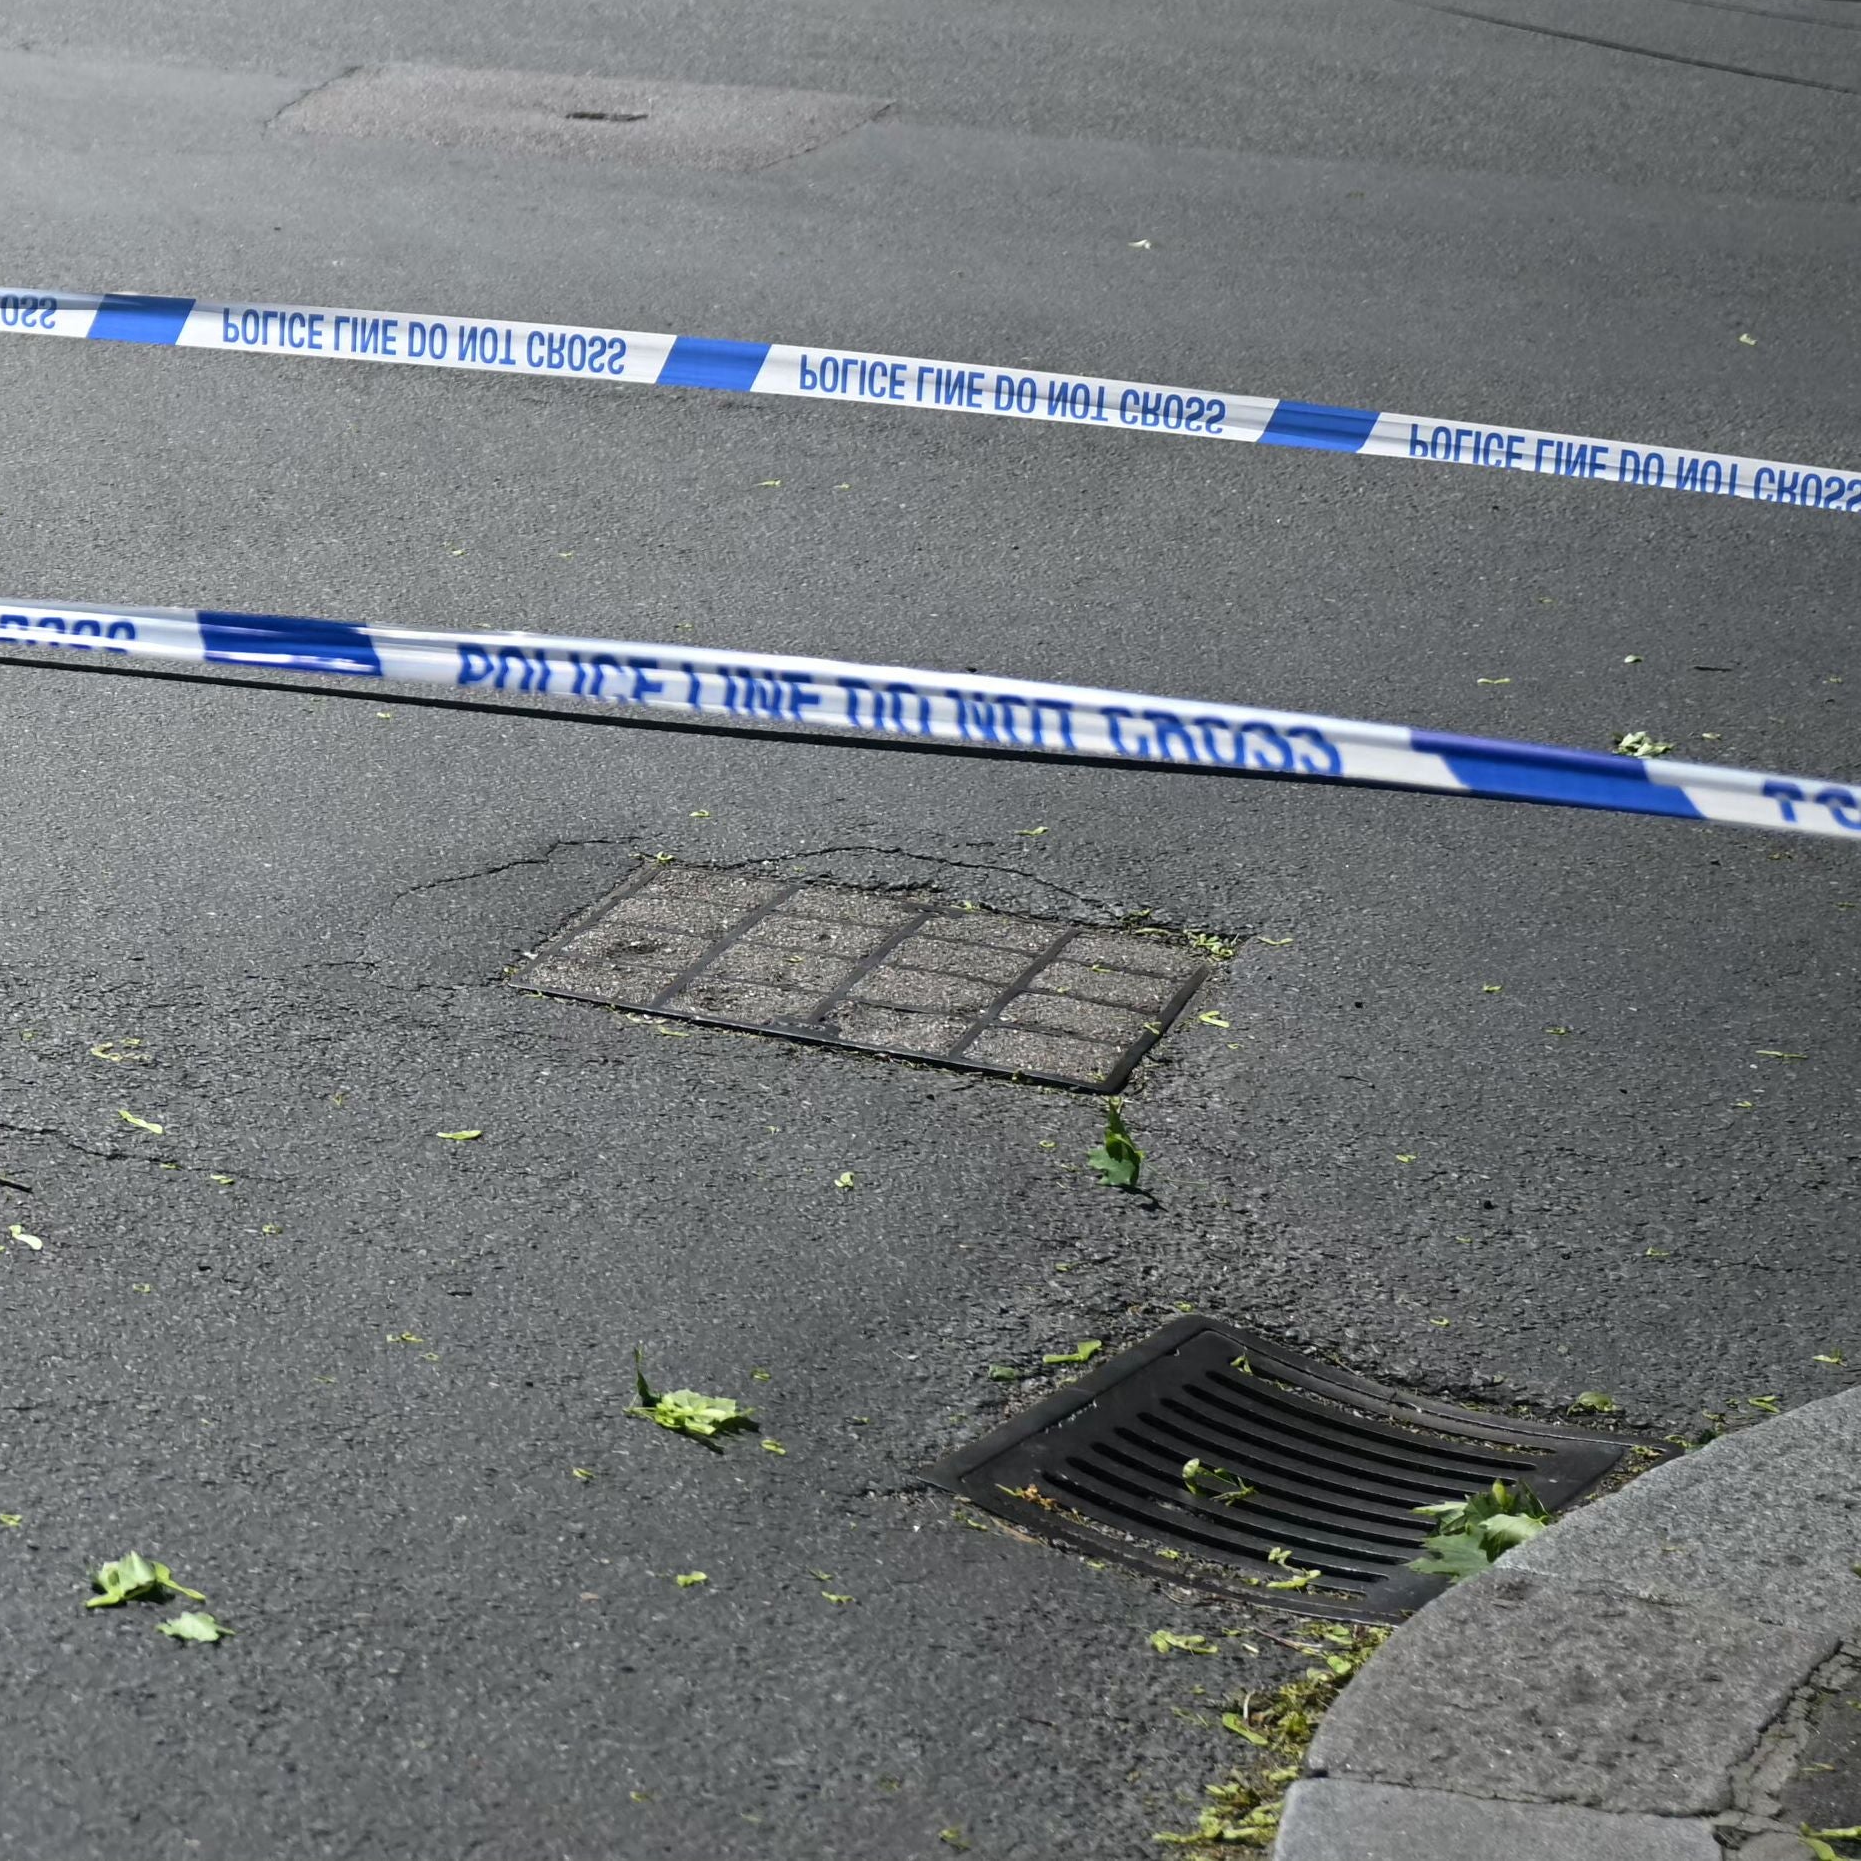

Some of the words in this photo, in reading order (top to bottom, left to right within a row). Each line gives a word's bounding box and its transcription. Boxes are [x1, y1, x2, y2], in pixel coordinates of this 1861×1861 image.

[456, 643, 665, 705] POLICE
[682, 661, 821, 722] LINE
[837, 677, 933, 734] DO
[946, 688, 1076, 752] NOT
[1100, 706, 1343, 776] CROSS
